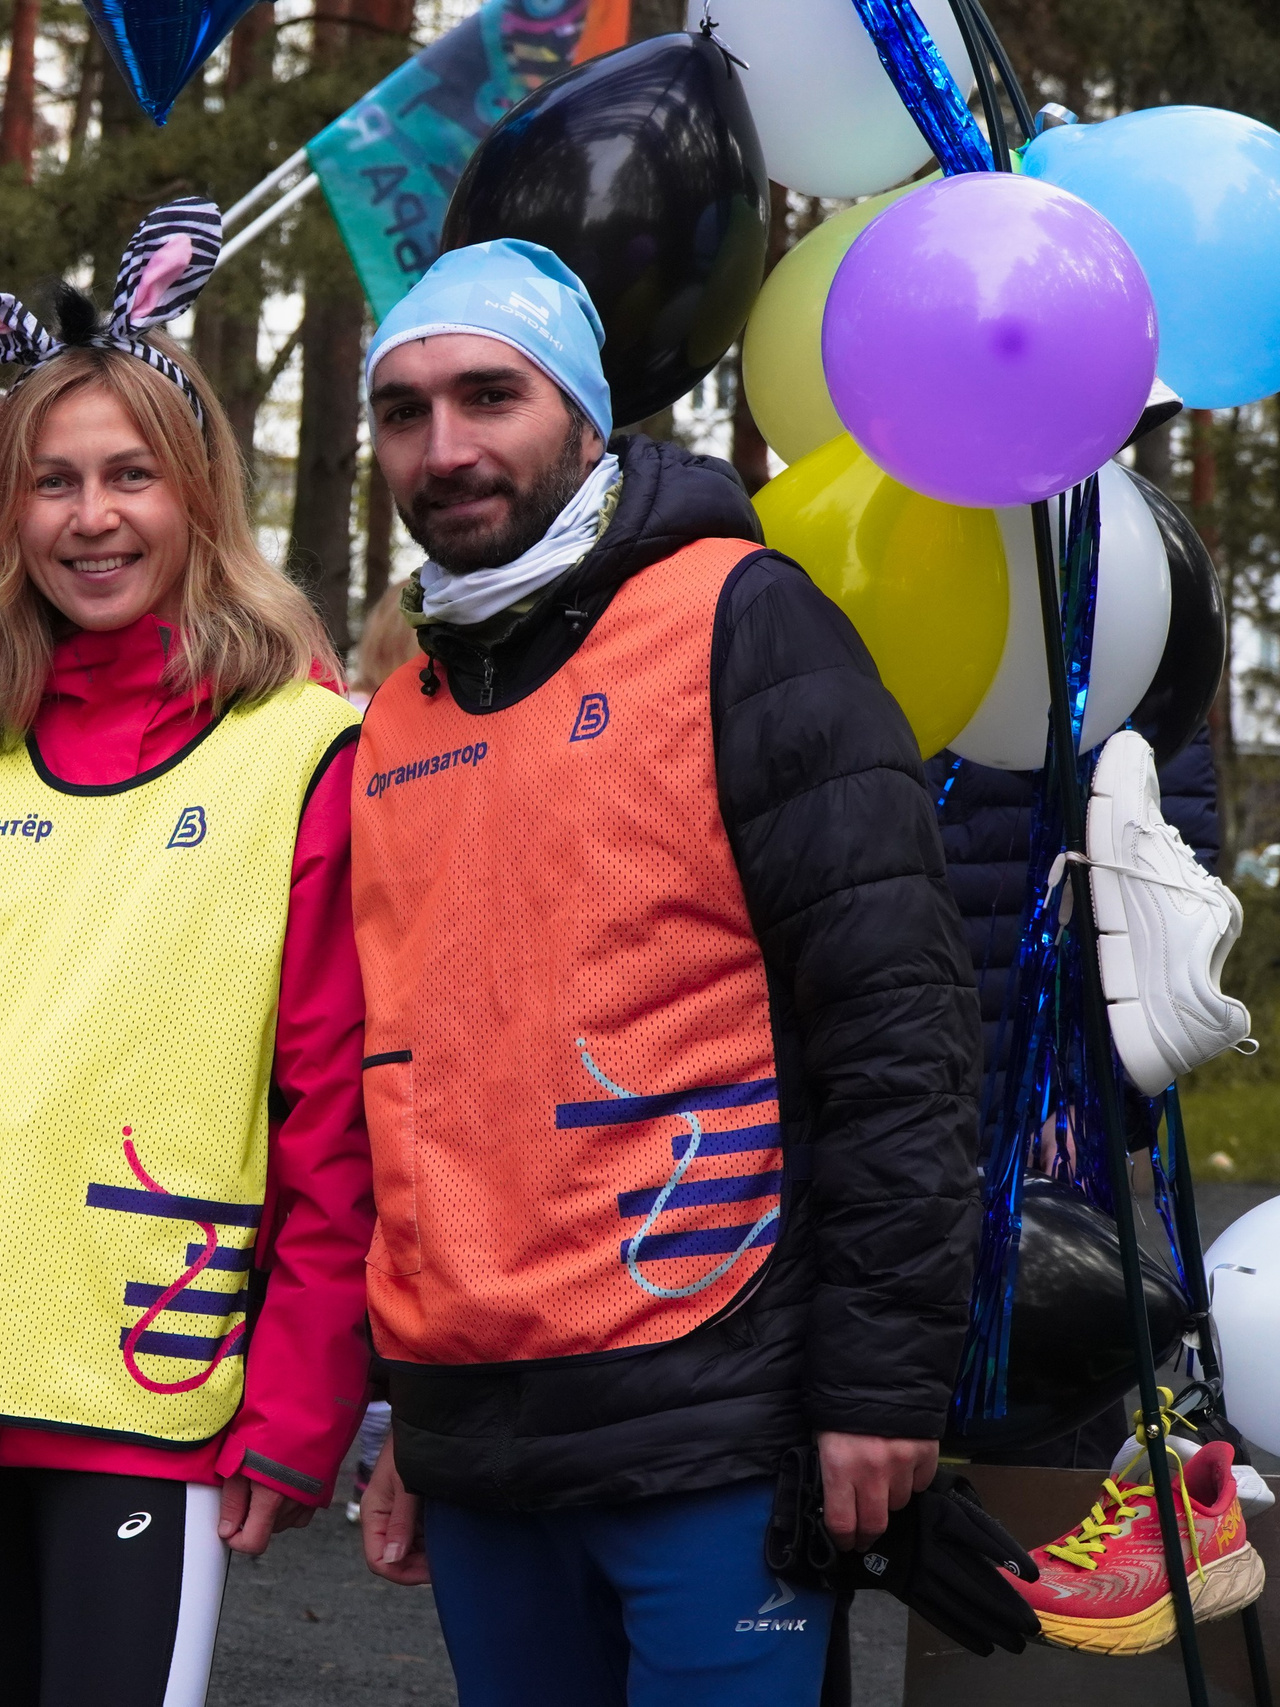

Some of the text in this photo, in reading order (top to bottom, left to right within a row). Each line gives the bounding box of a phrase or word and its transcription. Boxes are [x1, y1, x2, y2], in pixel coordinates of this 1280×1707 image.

[484, 299, 564, 352] NORDSKI
[365, 741, 489, 799] Организатор
[734, 1618, 808, 1633] DEMIX
